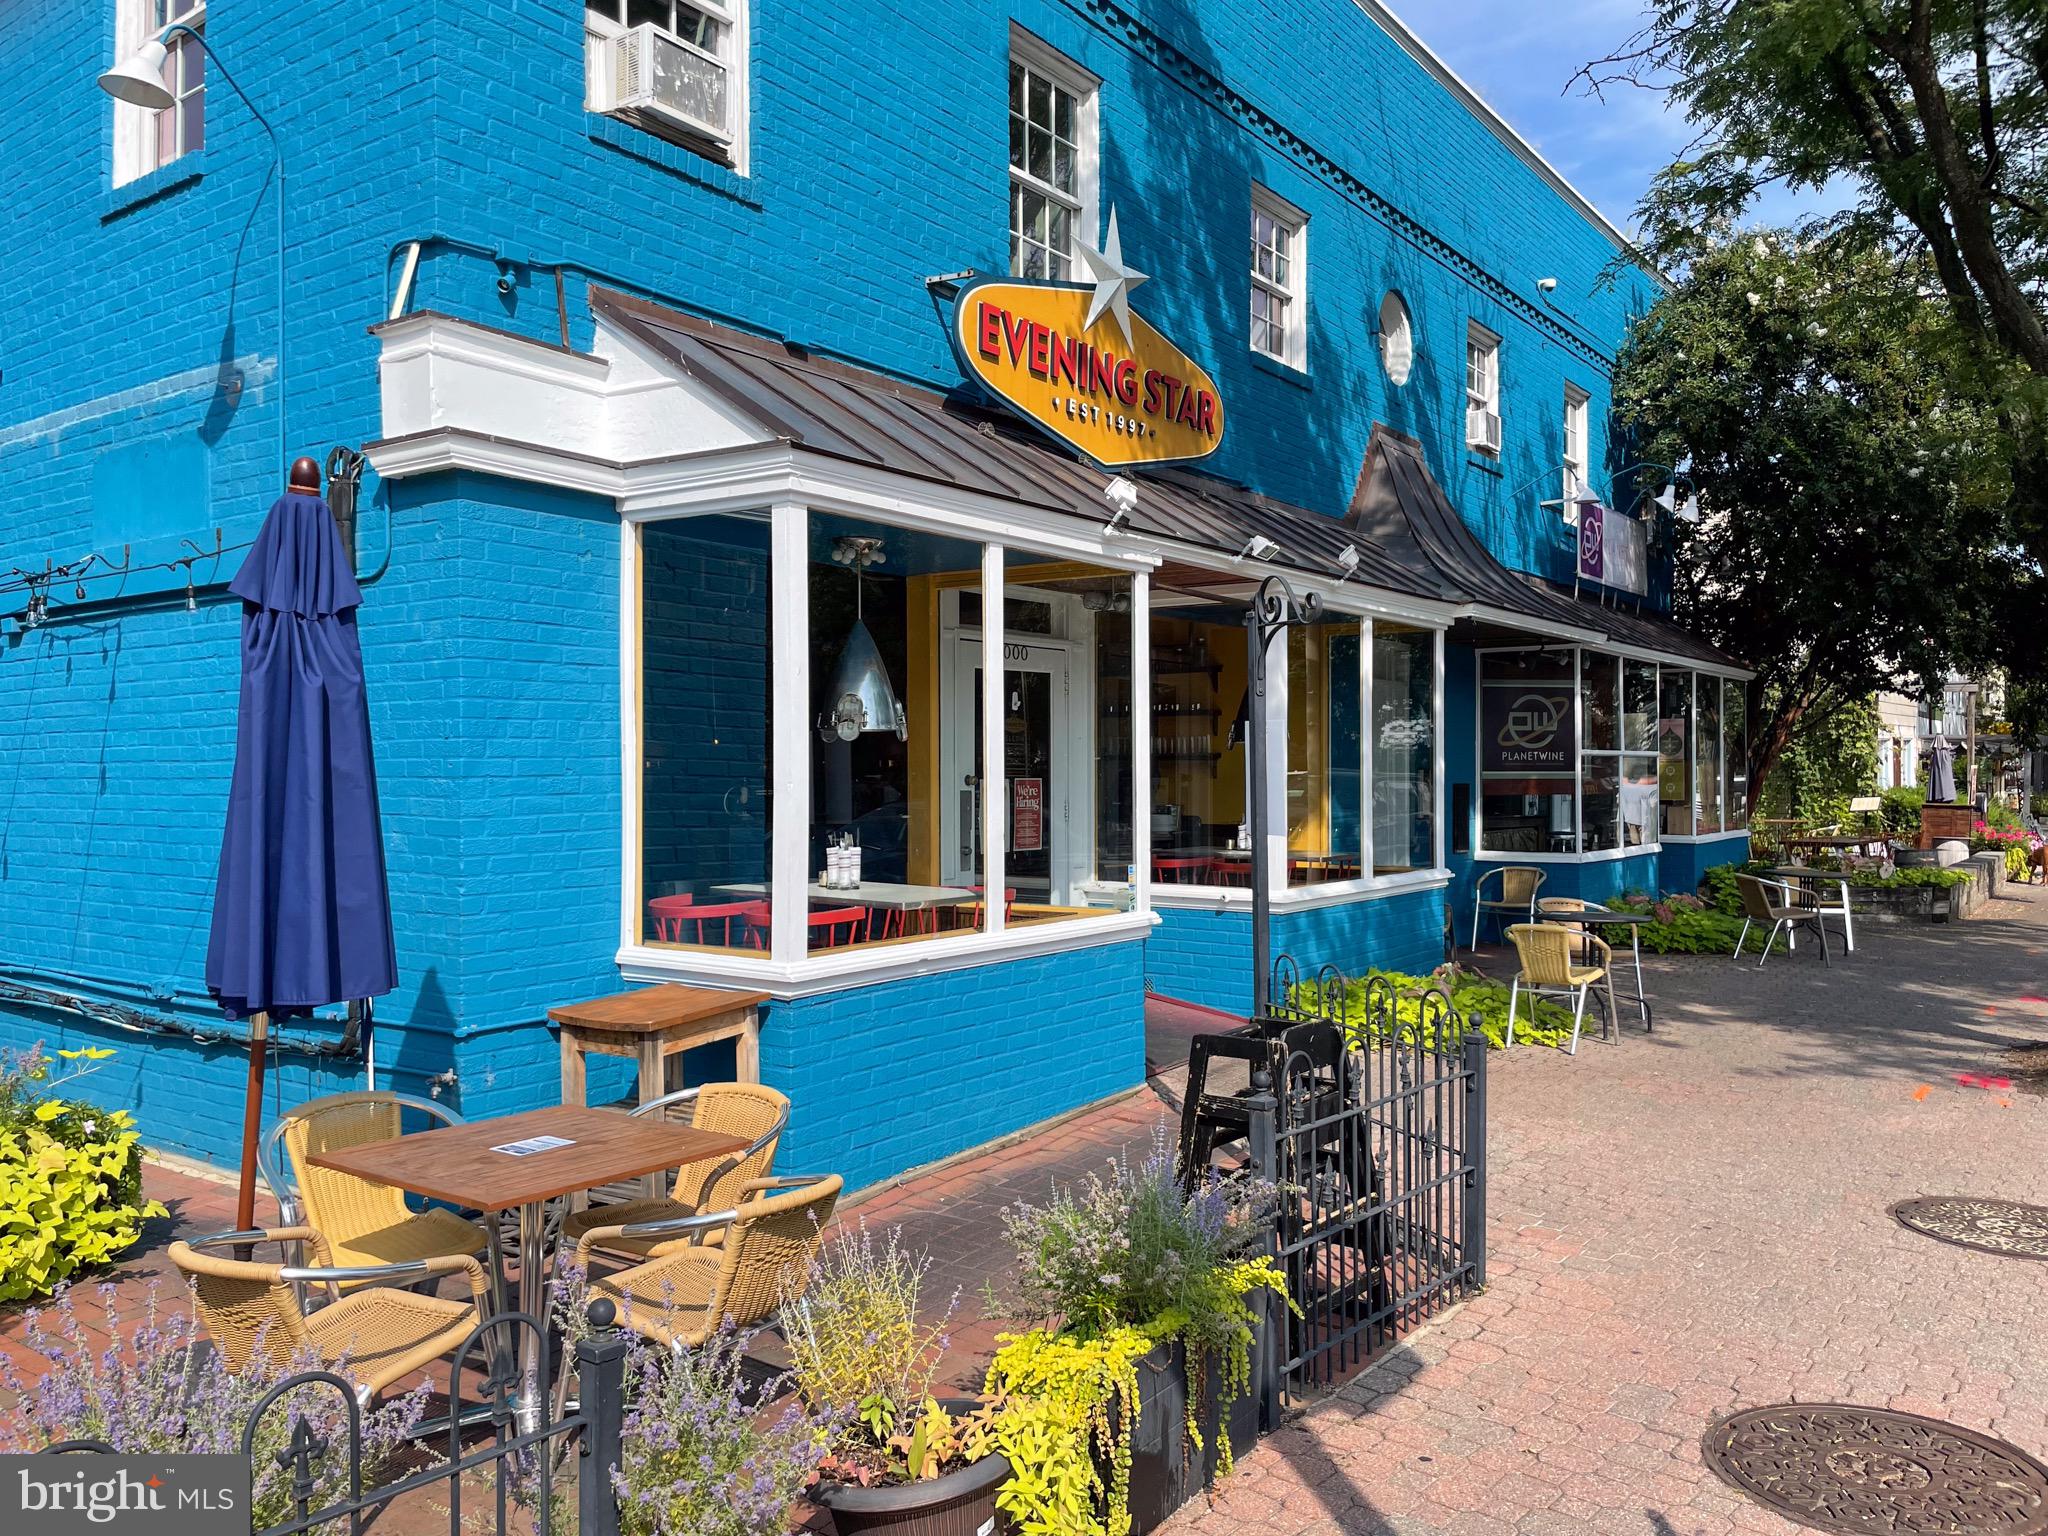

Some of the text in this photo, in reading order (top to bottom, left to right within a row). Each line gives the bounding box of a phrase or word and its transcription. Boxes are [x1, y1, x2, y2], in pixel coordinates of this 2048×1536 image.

[977, 300, 1216, 435] EVENING STAR
[1067, 397, 1148, 437] EST 1997
[1003, 643, 1028, 661] 000
[1017, 785, 1039, 796] We're
[1016, 796, 1040, 811] Hiring
